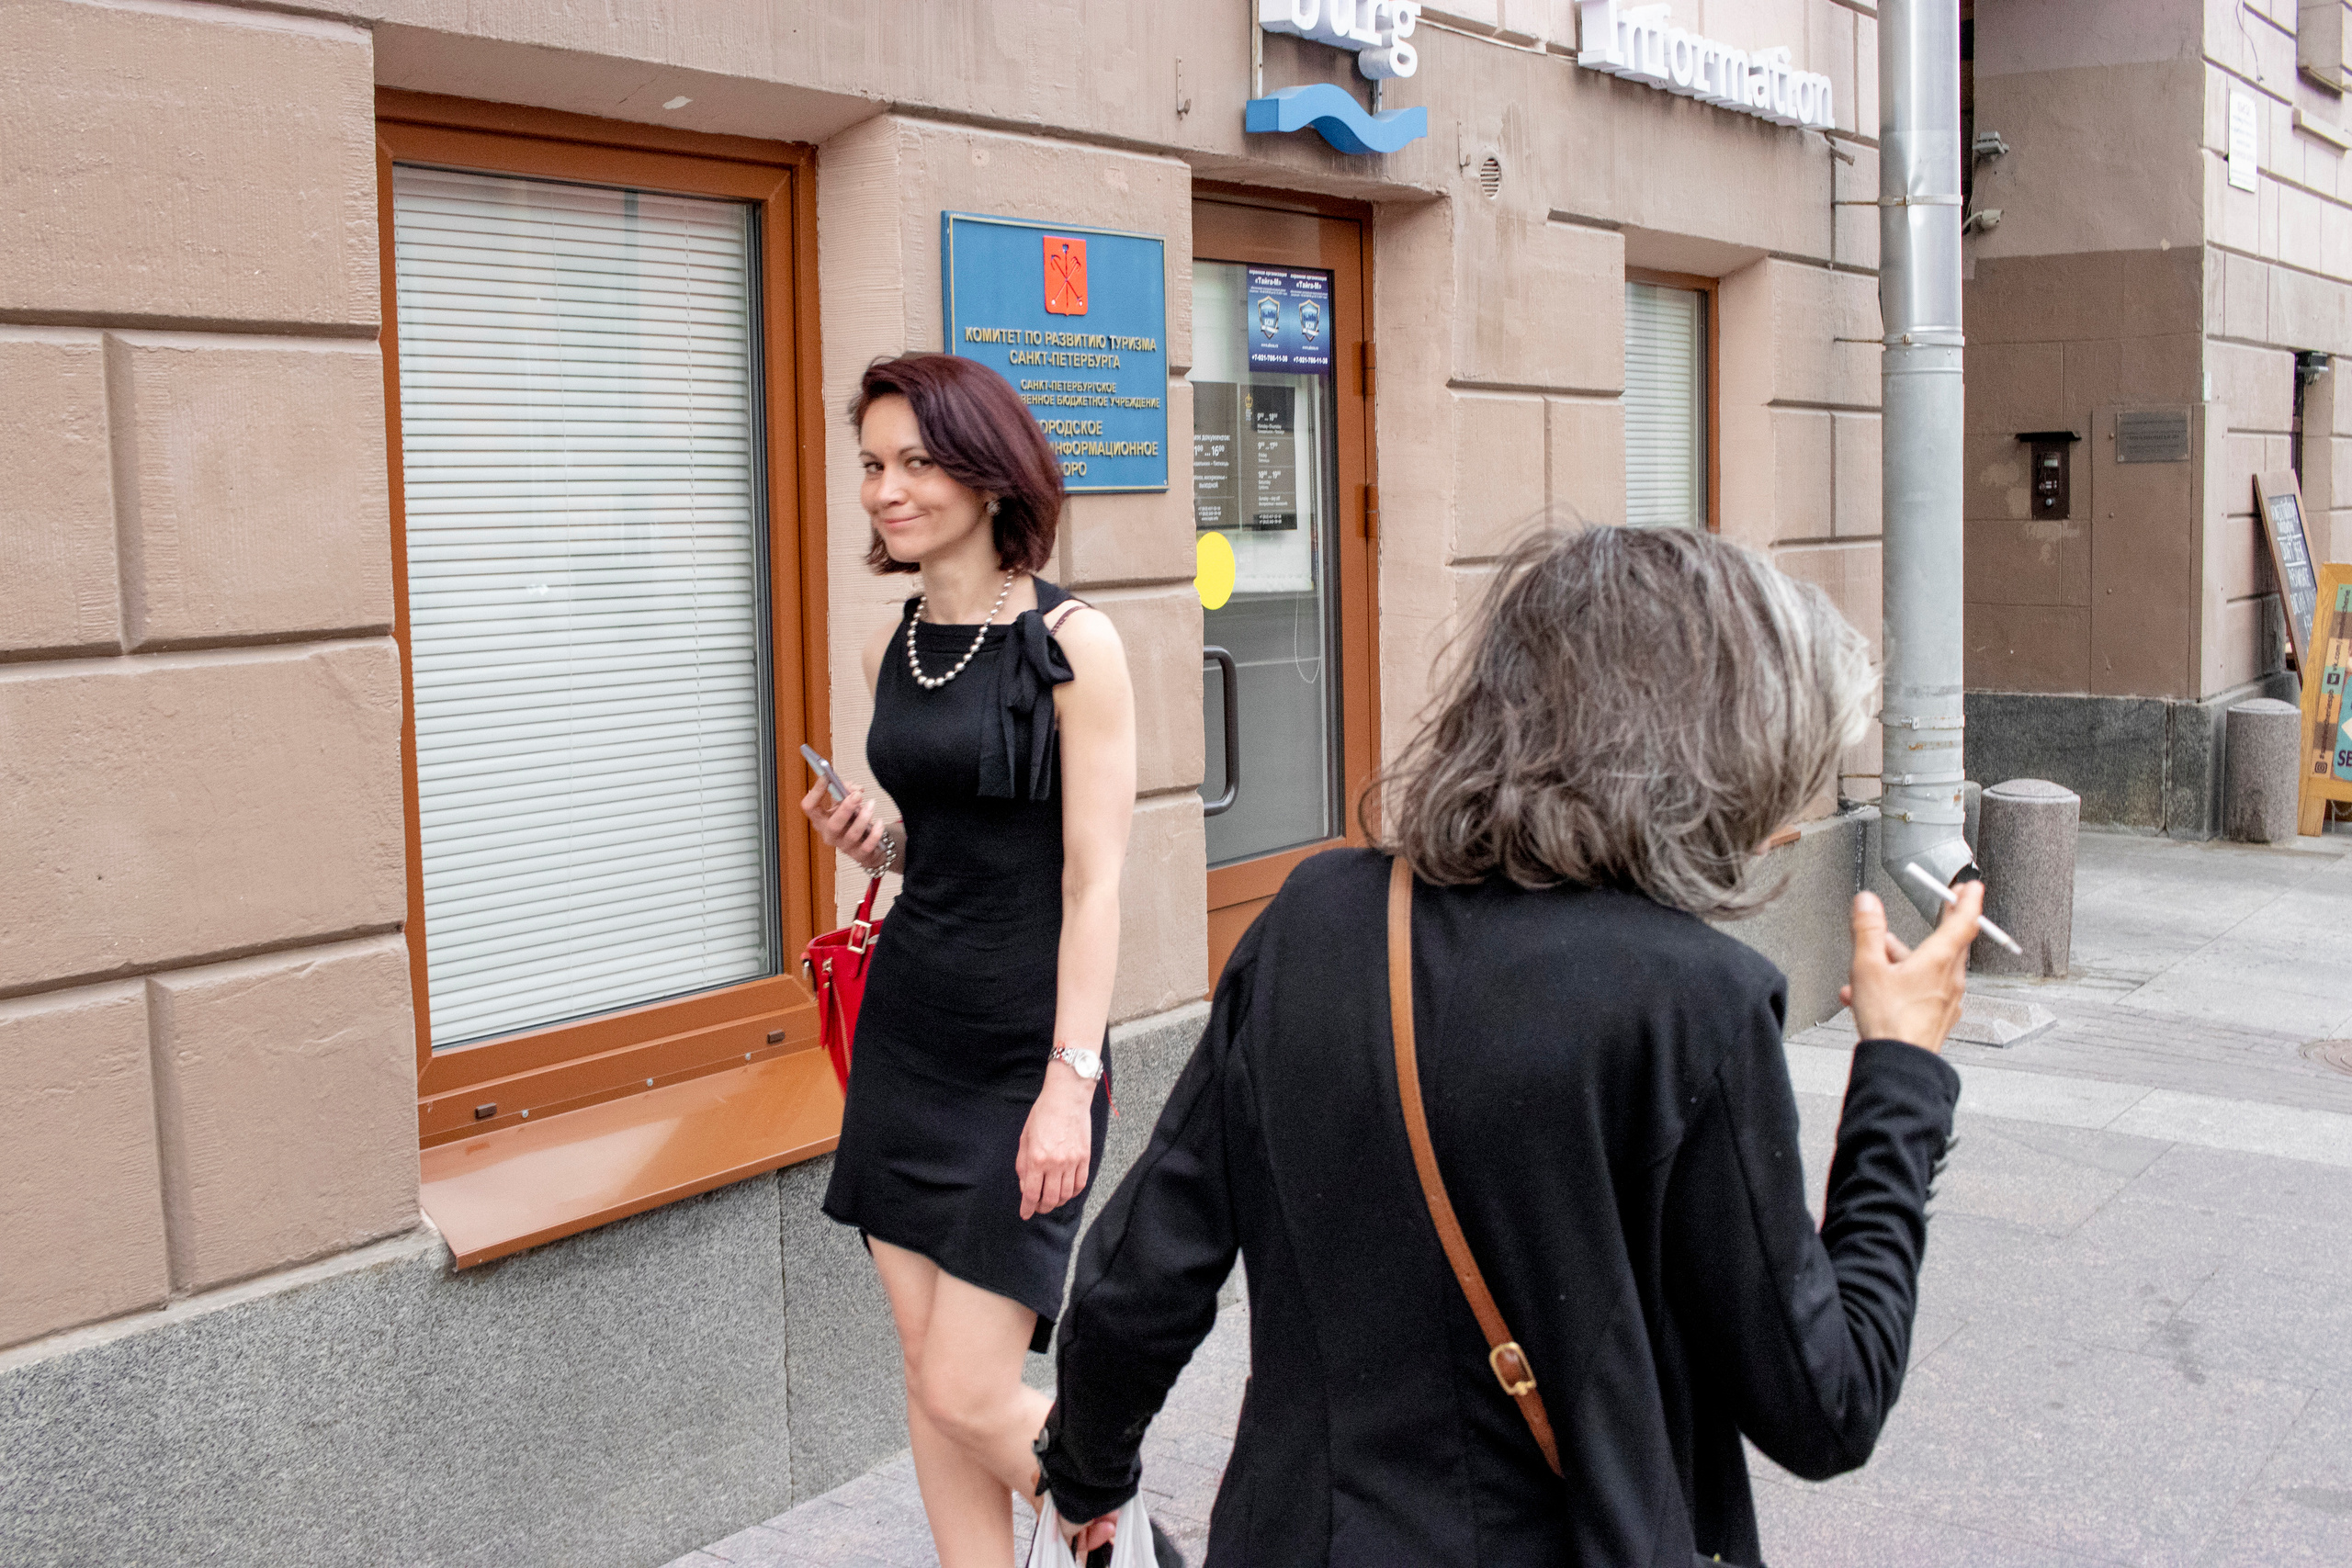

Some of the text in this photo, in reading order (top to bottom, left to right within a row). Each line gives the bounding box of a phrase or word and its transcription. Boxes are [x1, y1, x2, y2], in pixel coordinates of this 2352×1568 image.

[965, 327, 1157, 352] КОМИТЕТ ПО РАЗВИТИЮ ТУРИЗМА
[1010, 350, 1120, 368] САНКТ-ПЕТЕРБУРГА
[1020, 379, 1116, 394] САНКТ-ПЕТЕРБУРГСКОЕ
[1057, 395, 1108, 408] БЮДЖЕТНОЕ
[1110, 397, 1160, 410] УЧРЕЖДЕНИЕ
[1039, 420, 1103, 437] ОРОДСКОЕ
